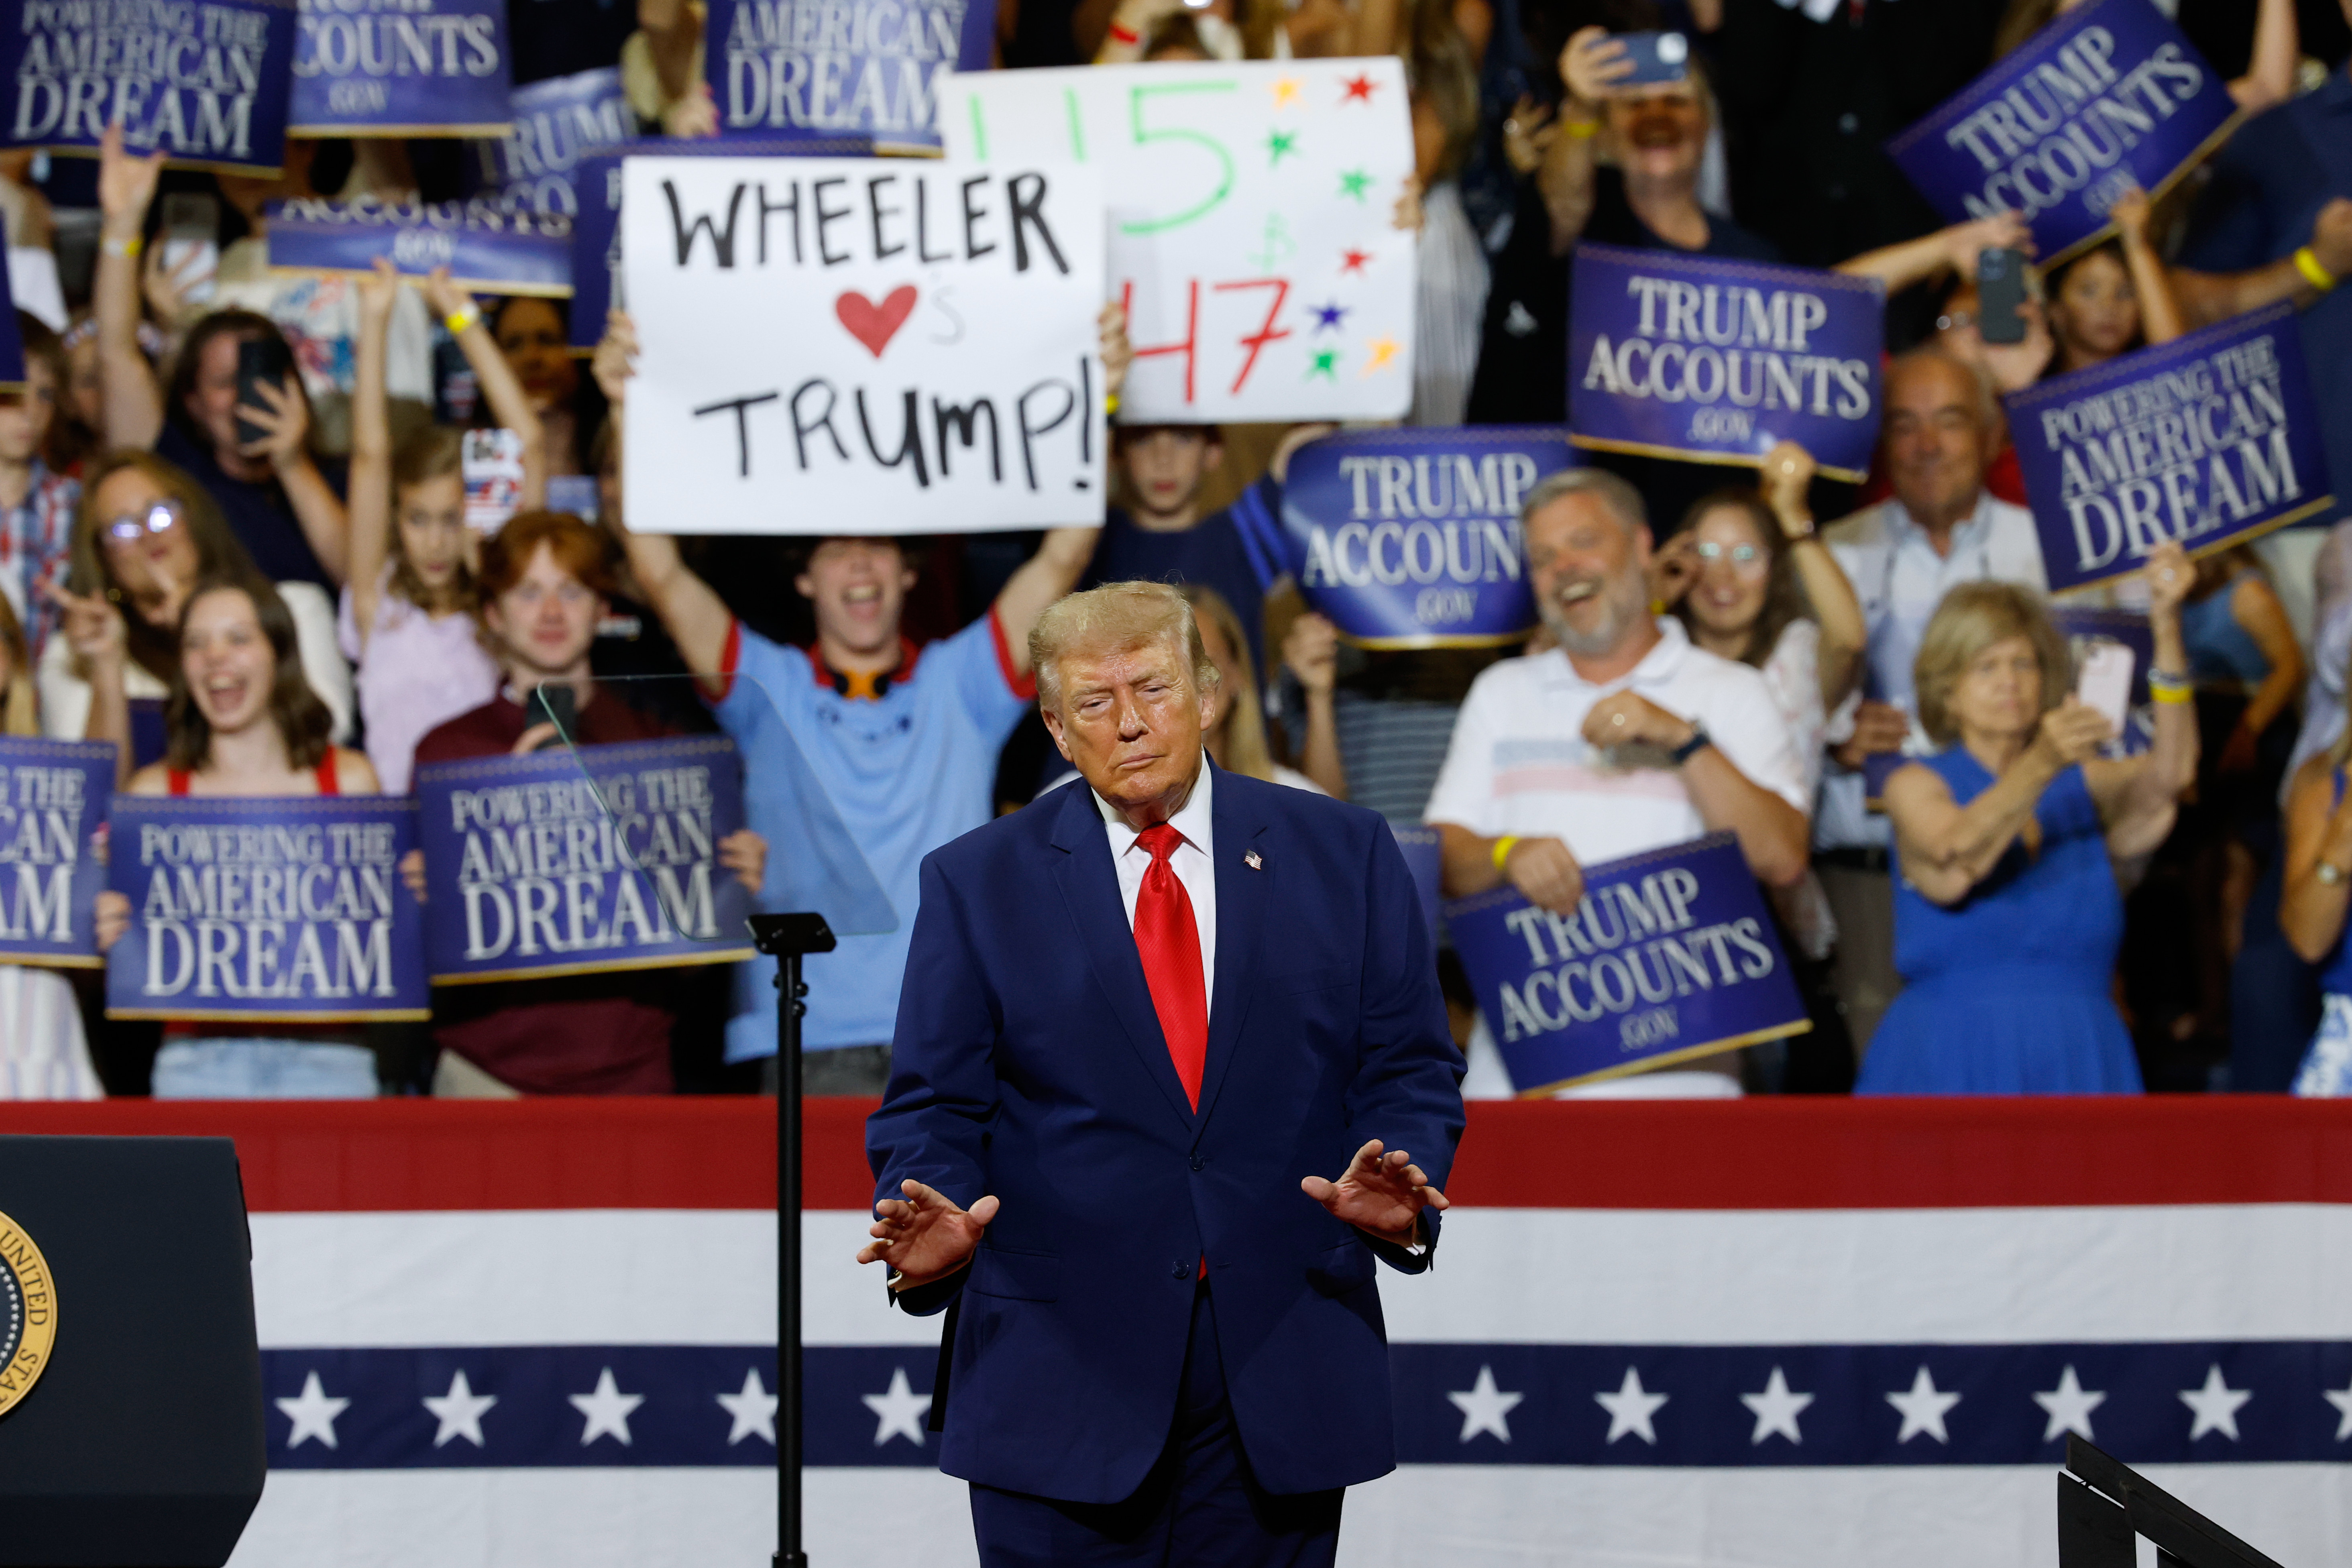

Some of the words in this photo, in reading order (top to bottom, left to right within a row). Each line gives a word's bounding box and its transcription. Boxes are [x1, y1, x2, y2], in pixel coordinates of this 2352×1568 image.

[16, 25, 266, 94] AMERICAN
[291, 13, 499, 77] COUNTS
[726, 0, 963, 59] AMERICAN
[11, 72, 252, 157] DREAM
[1943, 25, 2118, 173] TRUMP
[662, 172, 1069, 274] WHEELER
[1119, 278, 1292, 405] 47
[1627, 275, 1828, 352] TRUMP
[1581, 334, 1871, 421] ACCOUNTS
[2040, 360, 2213, 452] POWERING
[2211, 334, 2281, 389] THE
[1339, 453, 1537, 519] TRUMP
[2061, 381, 2288, 509] AMERICAN
[2067, 428, 2303, 572] DREAM
[1302, 519, 1523, 589] ACCOUN
[14, 766, 86, 811] THE
[450, 772, 635, 833] POWERING
[640, 765, 713, 813] THE
[141, 823, 321, 867] POWERING
[326, 822, 396, 865] THE
[459, 809, 713, 886] AMERICAN
[143, 864, 394, 918] AMERICAN
[462, 861, 720, 961] DREAM
[1503, 867, 1700, 968] TRUMP
[141, 917, 397, 998] DREAM
[1499, 916, 1774, 1044] ACCOUNTS
[0, 1229, 47, 1326] UNITED
